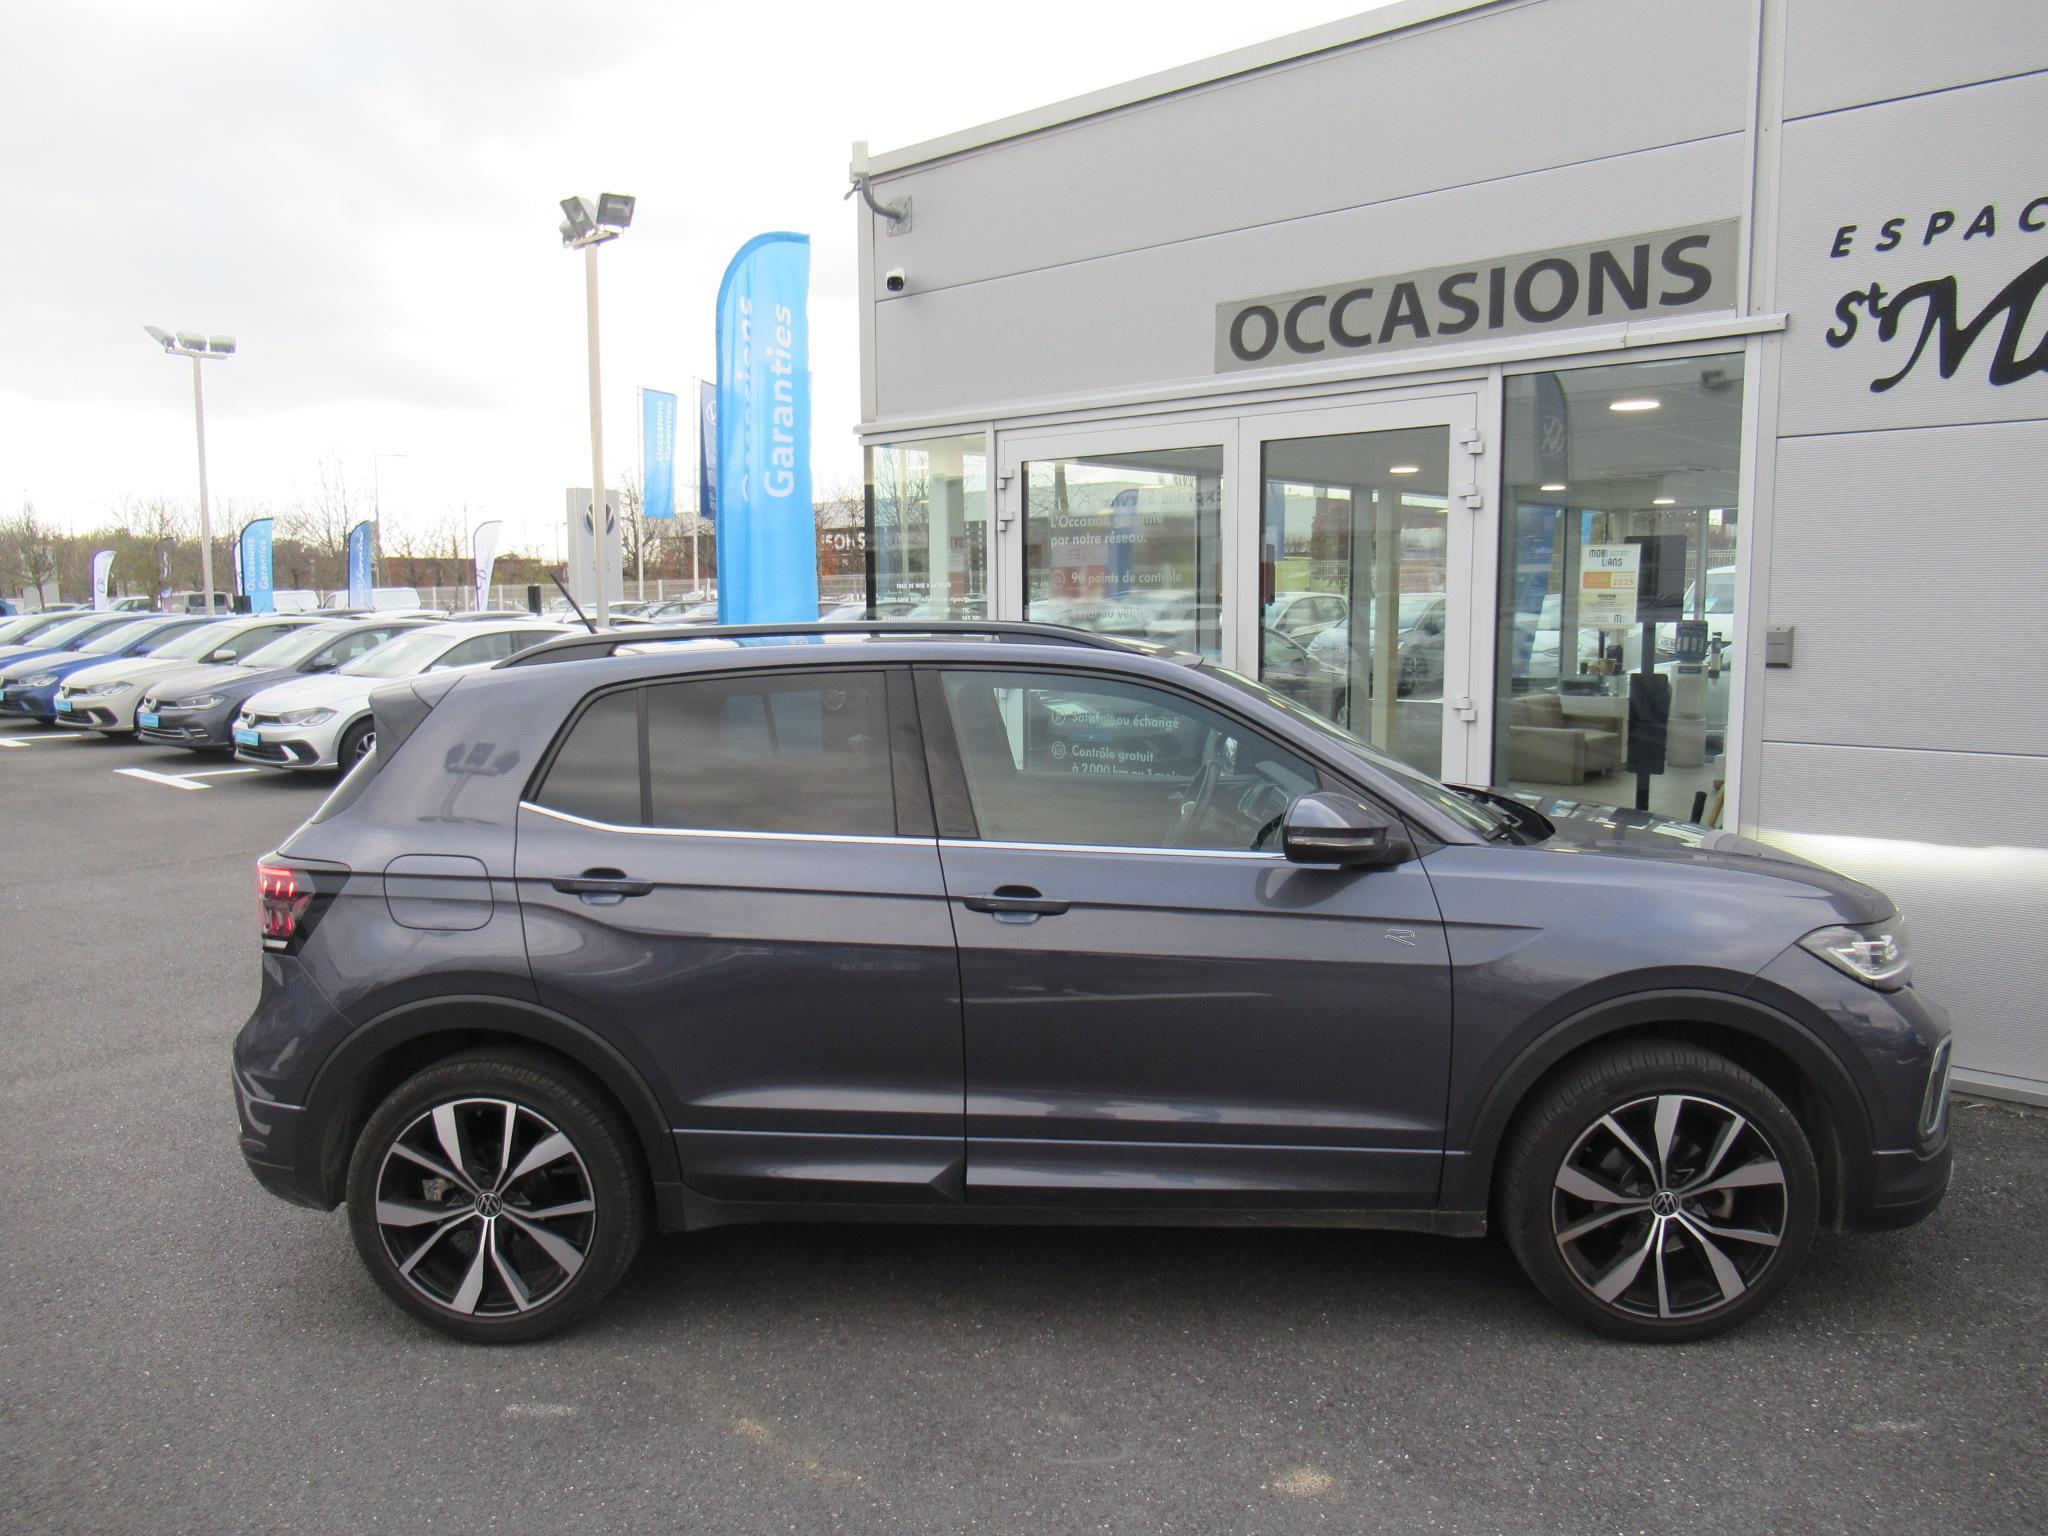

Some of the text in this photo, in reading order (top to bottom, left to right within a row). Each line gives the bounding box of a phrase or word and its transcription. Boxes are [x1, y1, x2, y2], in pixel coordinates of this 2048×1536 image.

[1829, 196, 2048, 259] ESPAC
[1229, 234, 1713, 362] OCCASIONS
[763, 303, 796, 499] Garanties
[655, 398, 665, 463] Occasions
[246, 538, 257, 592] Occasions
[1050, 531, 1147, 549] par notre réseau.
[1088, 571, 1120, 586] points
[1122, 569, 1136, 583] de
[1138, 568, 1183, 583] contrôle
[1117, 717, 1130, 726] ou
[1133, 713, 1180, 731] échangé
[1072, 744, 1154, 763] Contrôle gratuit
